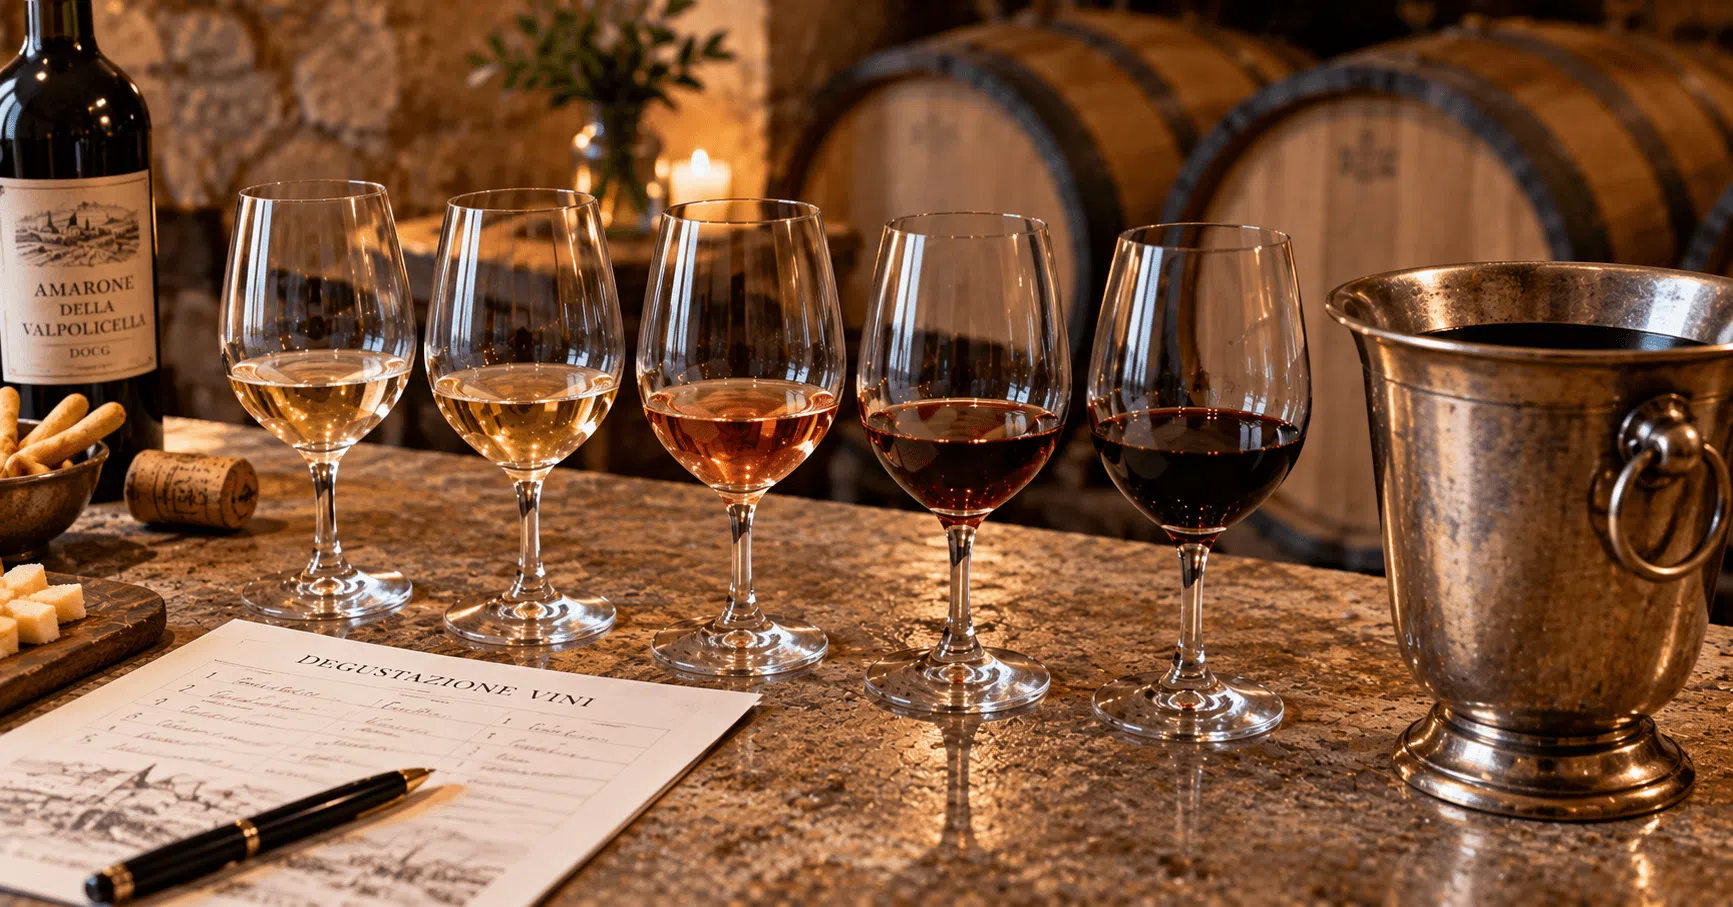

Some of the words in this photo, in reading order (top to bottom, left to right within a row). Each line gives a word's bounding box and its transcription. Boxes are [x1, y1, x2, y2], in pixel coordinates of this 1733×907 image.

[34, 275, 135, 297] AMARONE
[59, 300, 115, 317] DELLA
[22, 313, 147, 337] VALPOLICELLA
[69, 345, 111, 359] DOCG
[295, 654, 517, 697] DEGUSTAZIONE
[529, 689, 597, 708] VINI
